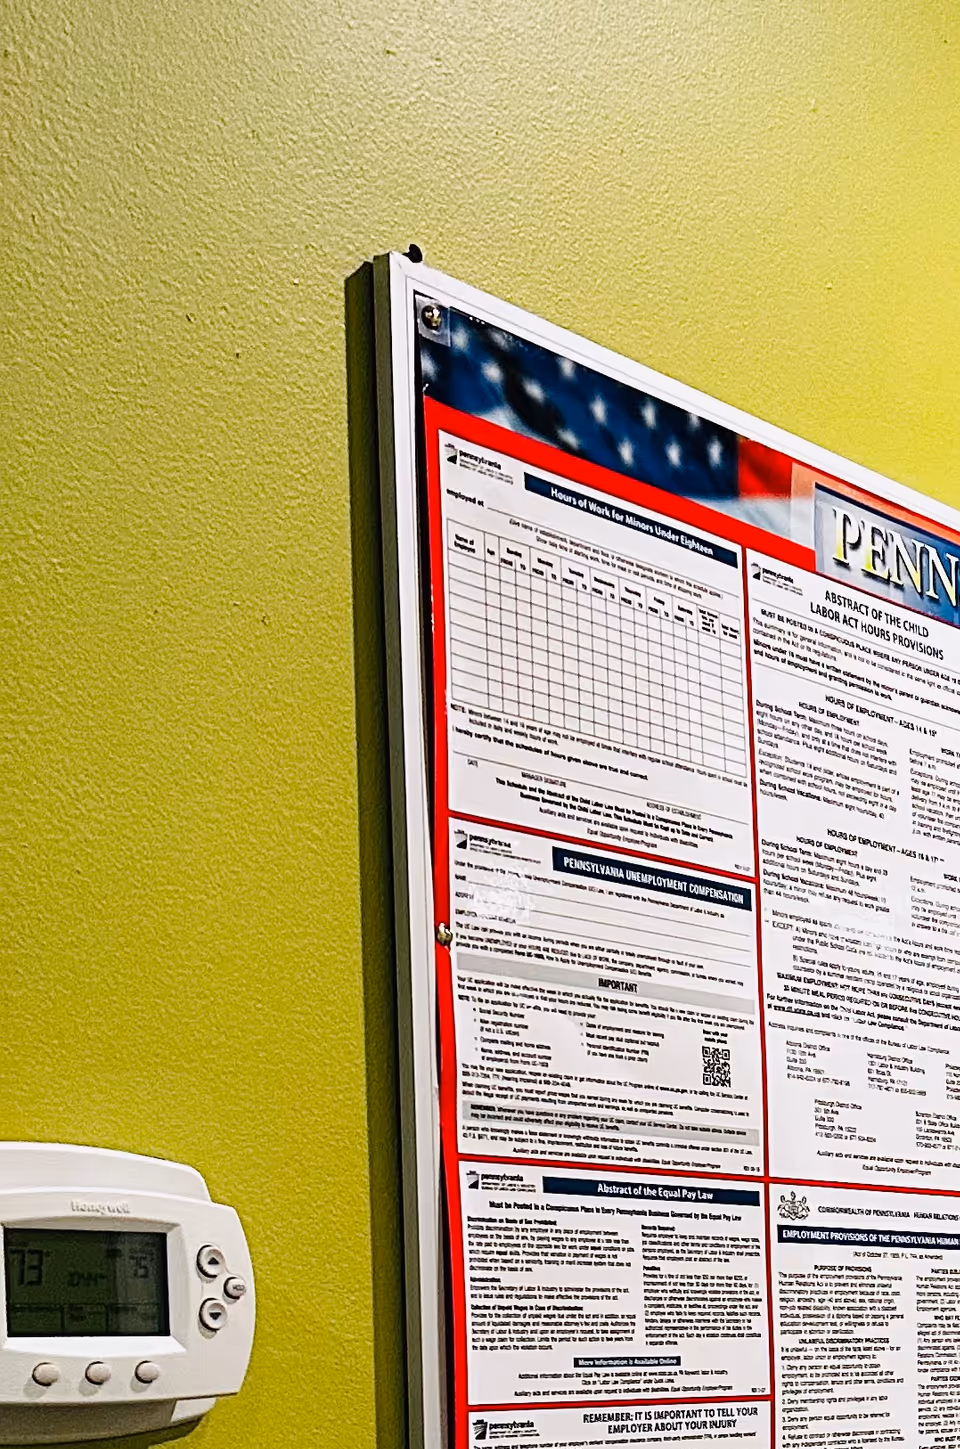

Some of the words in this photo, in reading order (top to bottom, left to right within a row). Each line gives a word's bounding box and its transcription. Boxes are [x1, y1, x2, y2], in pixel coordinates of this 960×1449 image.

[551, 487, 576, 504] Hours
[578, 498, 586, 508] of
[588, 501, 610, 517] Work
[612, 509, 623, 521] for
[625, 514, 653, 532] Minors
[654, 525, 678, 541] Under
[680, 535, 713, 554] Eighteen
[810, 602, 840, 622] LABOR
[842, 614, 858, 629] ACT
[861, 622, 890, 641] HOURS
[892, 633, 943, 659] PROVISIONS
[825, 591, 868, 615] ABSTRACT
[871, 608, 882, 620] OF
[884, 612, 901, 628] THE
[903, 620, 928, 637] CHILD
[563, 857, 624, 877] PENNSYLVANIA
[626, 870, 686, 890] UNEMPLOYMENT
[689, 883, 743, 903] COMPENSATION
[598, 978, 637, 992] IMPORTANT
[597, 1183, 631, 1194] Abstract
[633, 1185, 641, 1195] of
[643, 1186, 656, 1196] the
[658, 1187, 680, 1198] Equal
[682, 1188, 696, 1200] Pay
[697, 1190, 713, 1199] Law
[10, 1250, 43, 1287] 73
[583, 1412, 633, 1423] REMEMBER:
[635, 1411, 642, 1420] IT
[644, 1410, 652, 1420] IS
[654, 1409, 702, 1419] IMPORTANT
[703, 1408, 714, 1417] TO
[717, 1407, 734, 1417] TELL
[736, 1407, 757, 1416] YOUR
[608, 1423, 652, 1433] EMPLOYER
[654, 1421, 682, 1431] ABOUT
[685, 1420, 707, 1429] YOUR
[709, 1419, 736, 1428] INJURY
